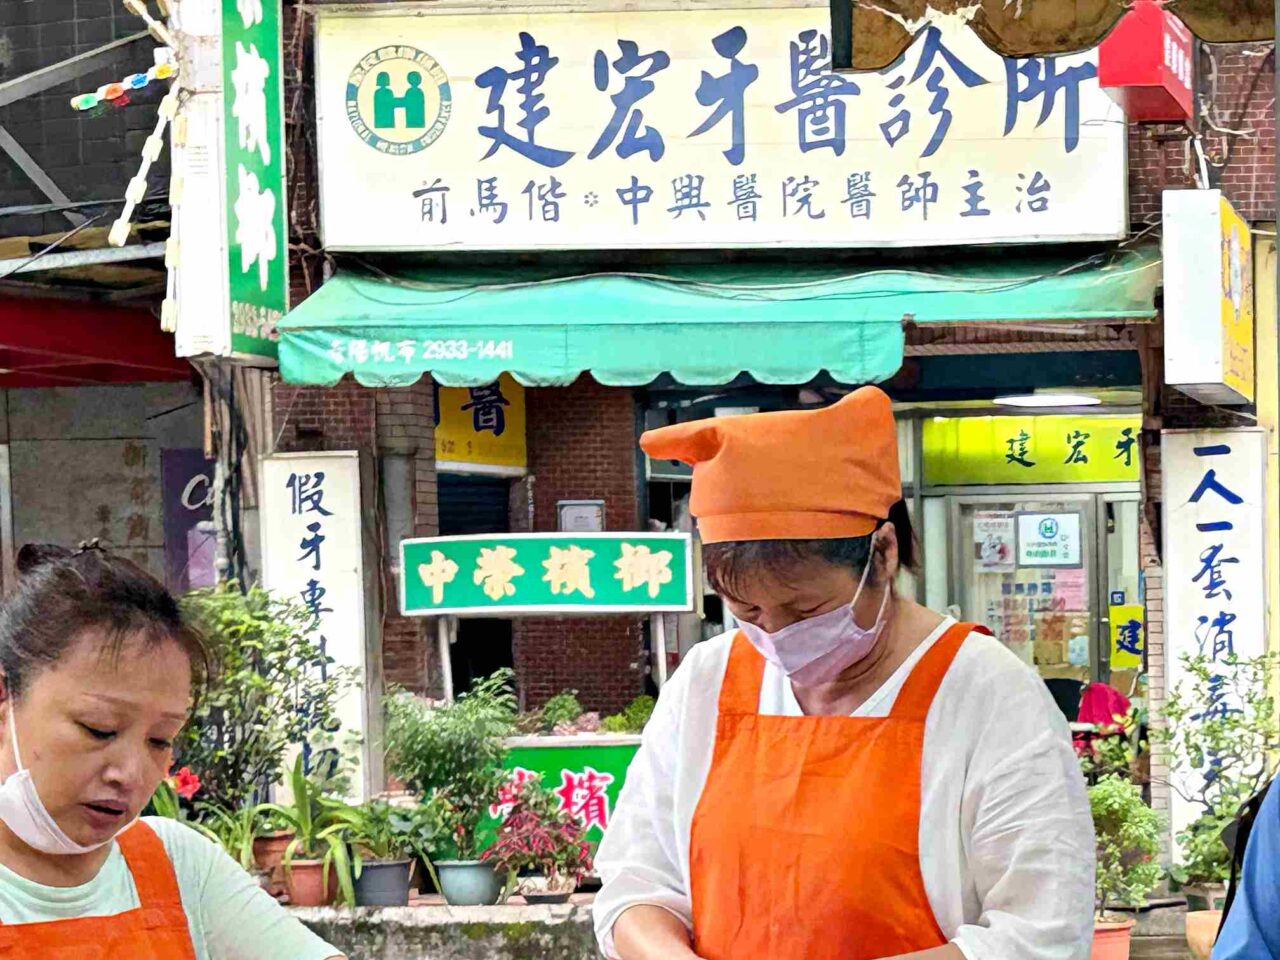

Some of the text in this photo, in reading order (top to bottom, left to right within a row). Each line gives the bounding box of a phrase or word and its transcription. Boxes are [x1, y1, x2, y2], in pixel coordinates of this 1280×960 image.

[474, 20, 1099, 168] 建宏牙醫診所
[1005, 428, 1136, 468] 建宏牙
